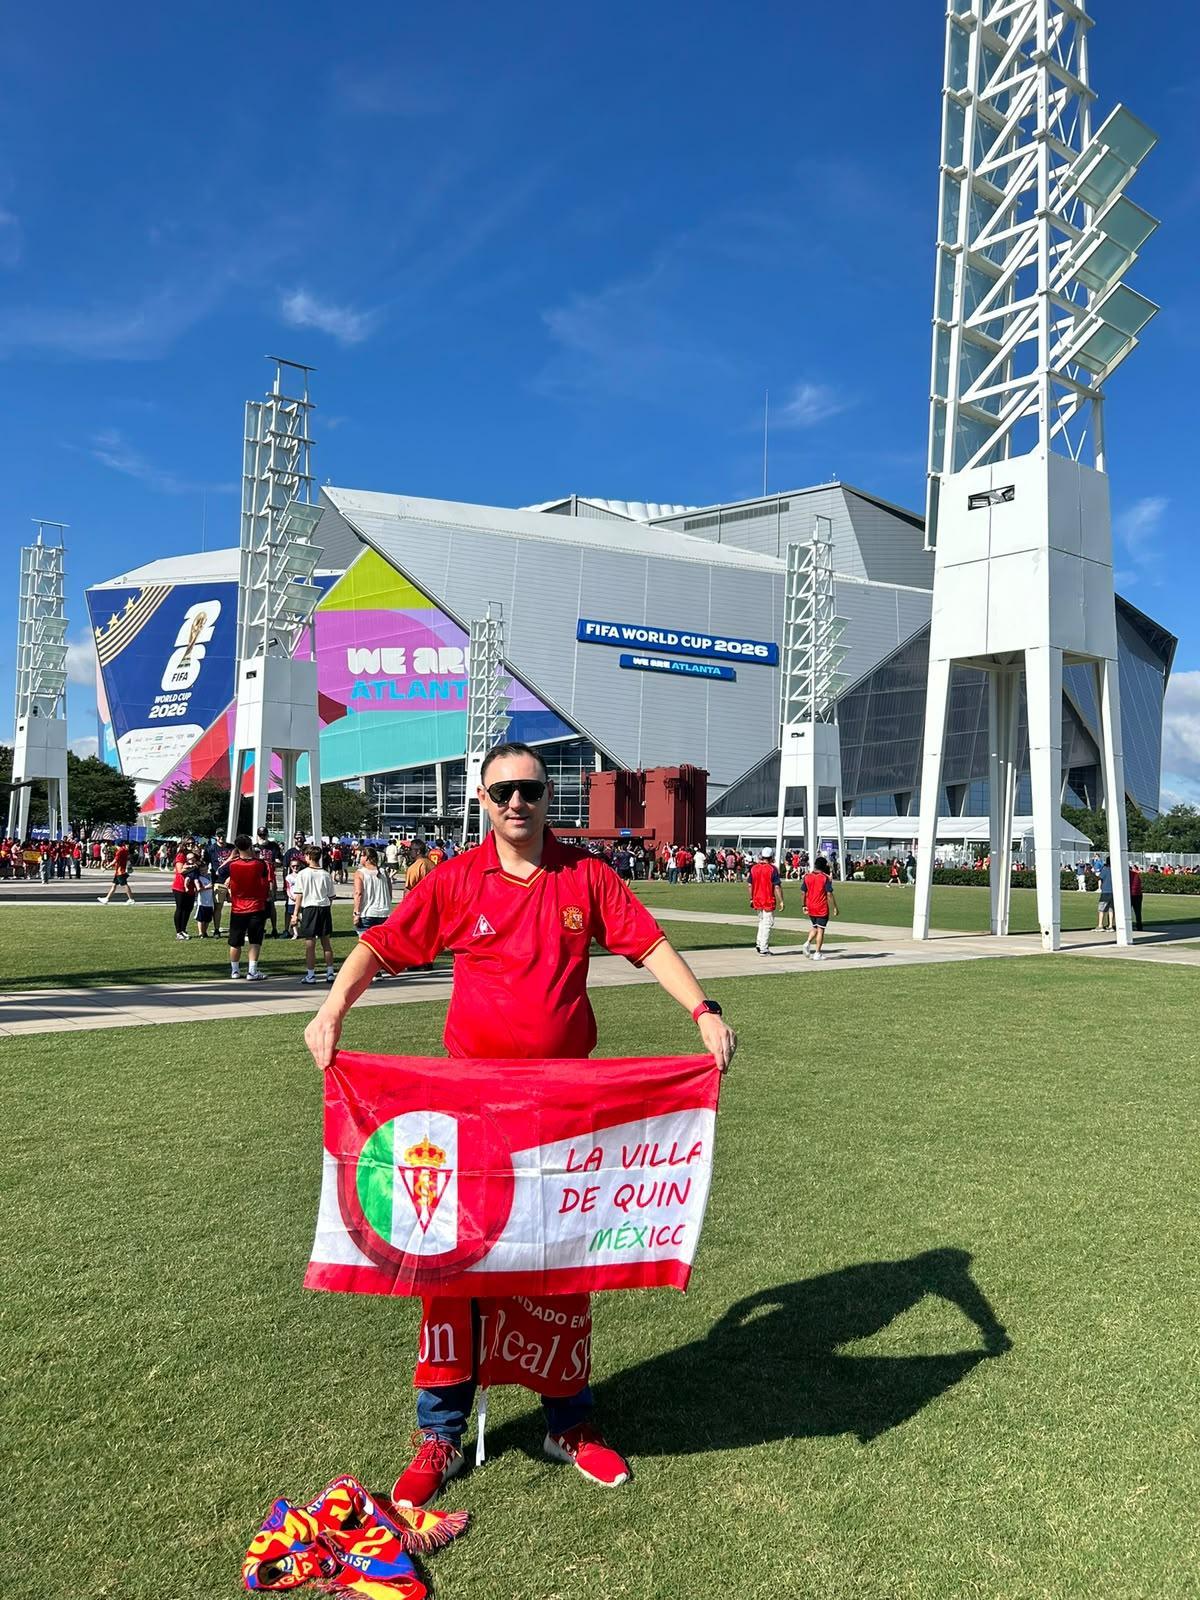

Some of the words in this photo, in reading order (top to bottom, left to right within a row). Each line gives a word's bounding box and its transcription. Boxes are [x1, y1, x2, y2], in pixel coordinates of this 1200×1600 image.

[586, 623, 619, 638] FIFA
[622, 627, 679, 646] WORLD
[681, 636, 713, 650] CUP
[714, 639, 769, 657] 2026
[347, 647, 407, 675] WE
[413, 647, 470, 674] AR
[671, 662, 721, 675] ATLANTA
[171, 672, 188, 682] FIFA
[154, 694, 179, 704] WORLD
[178, 692, 192, 702] CUP
[351, 679, 468, 700] ATLANT
[148, 702, 188, 719] 2026
[566, 1146, 604, 1172] LA
[622, 1141, 702, 1169] VILLA
[558, 1186, 600, 1213] DE
